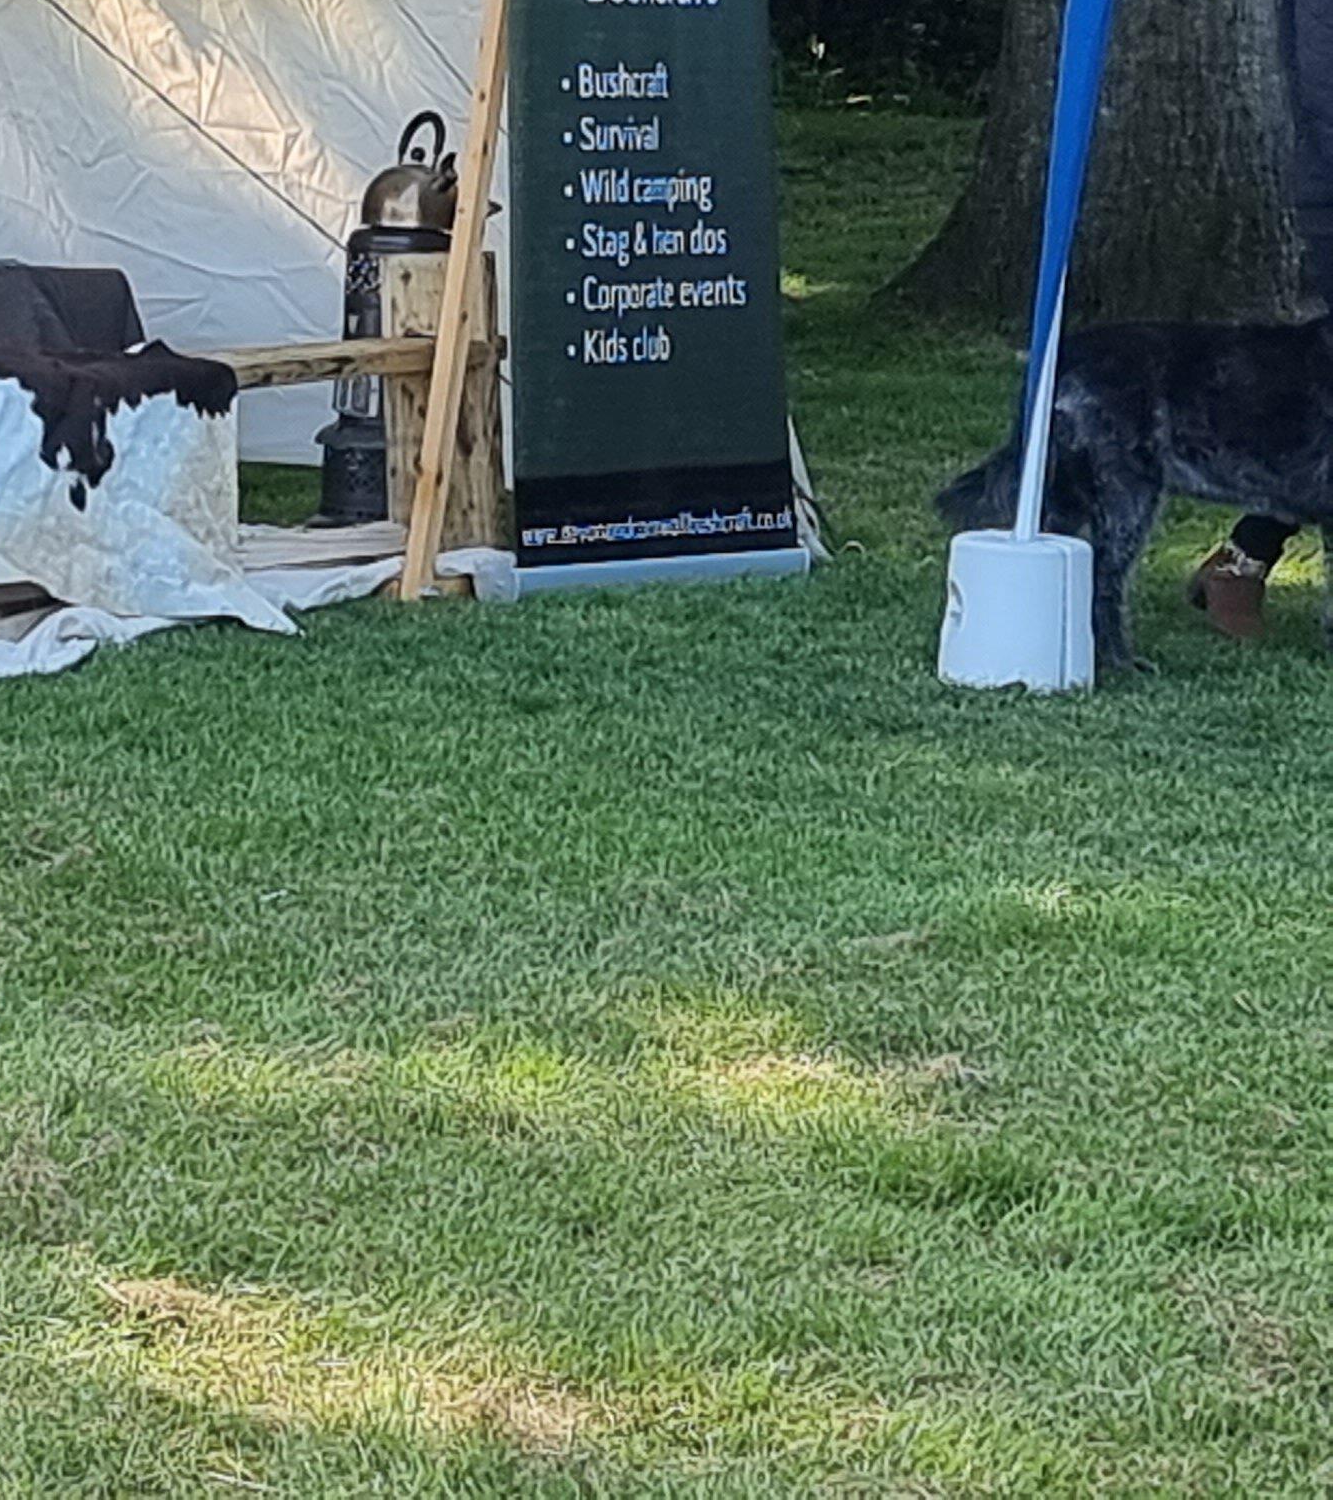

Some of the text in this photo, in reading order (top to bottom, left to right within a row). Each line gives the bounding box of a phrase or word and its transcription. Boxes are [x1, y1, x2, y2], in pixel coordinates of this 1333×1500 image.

[577, 61, 670, 99] Bushcraft
[579, 115, 660, 151] Survival
[579, 166, 714, 213] Wild camping
[582, 218, 728, 267] Stag & hen dos
[582, 272, 747, 319] Corporate events
[582, 324, 672, 365] Kids club
